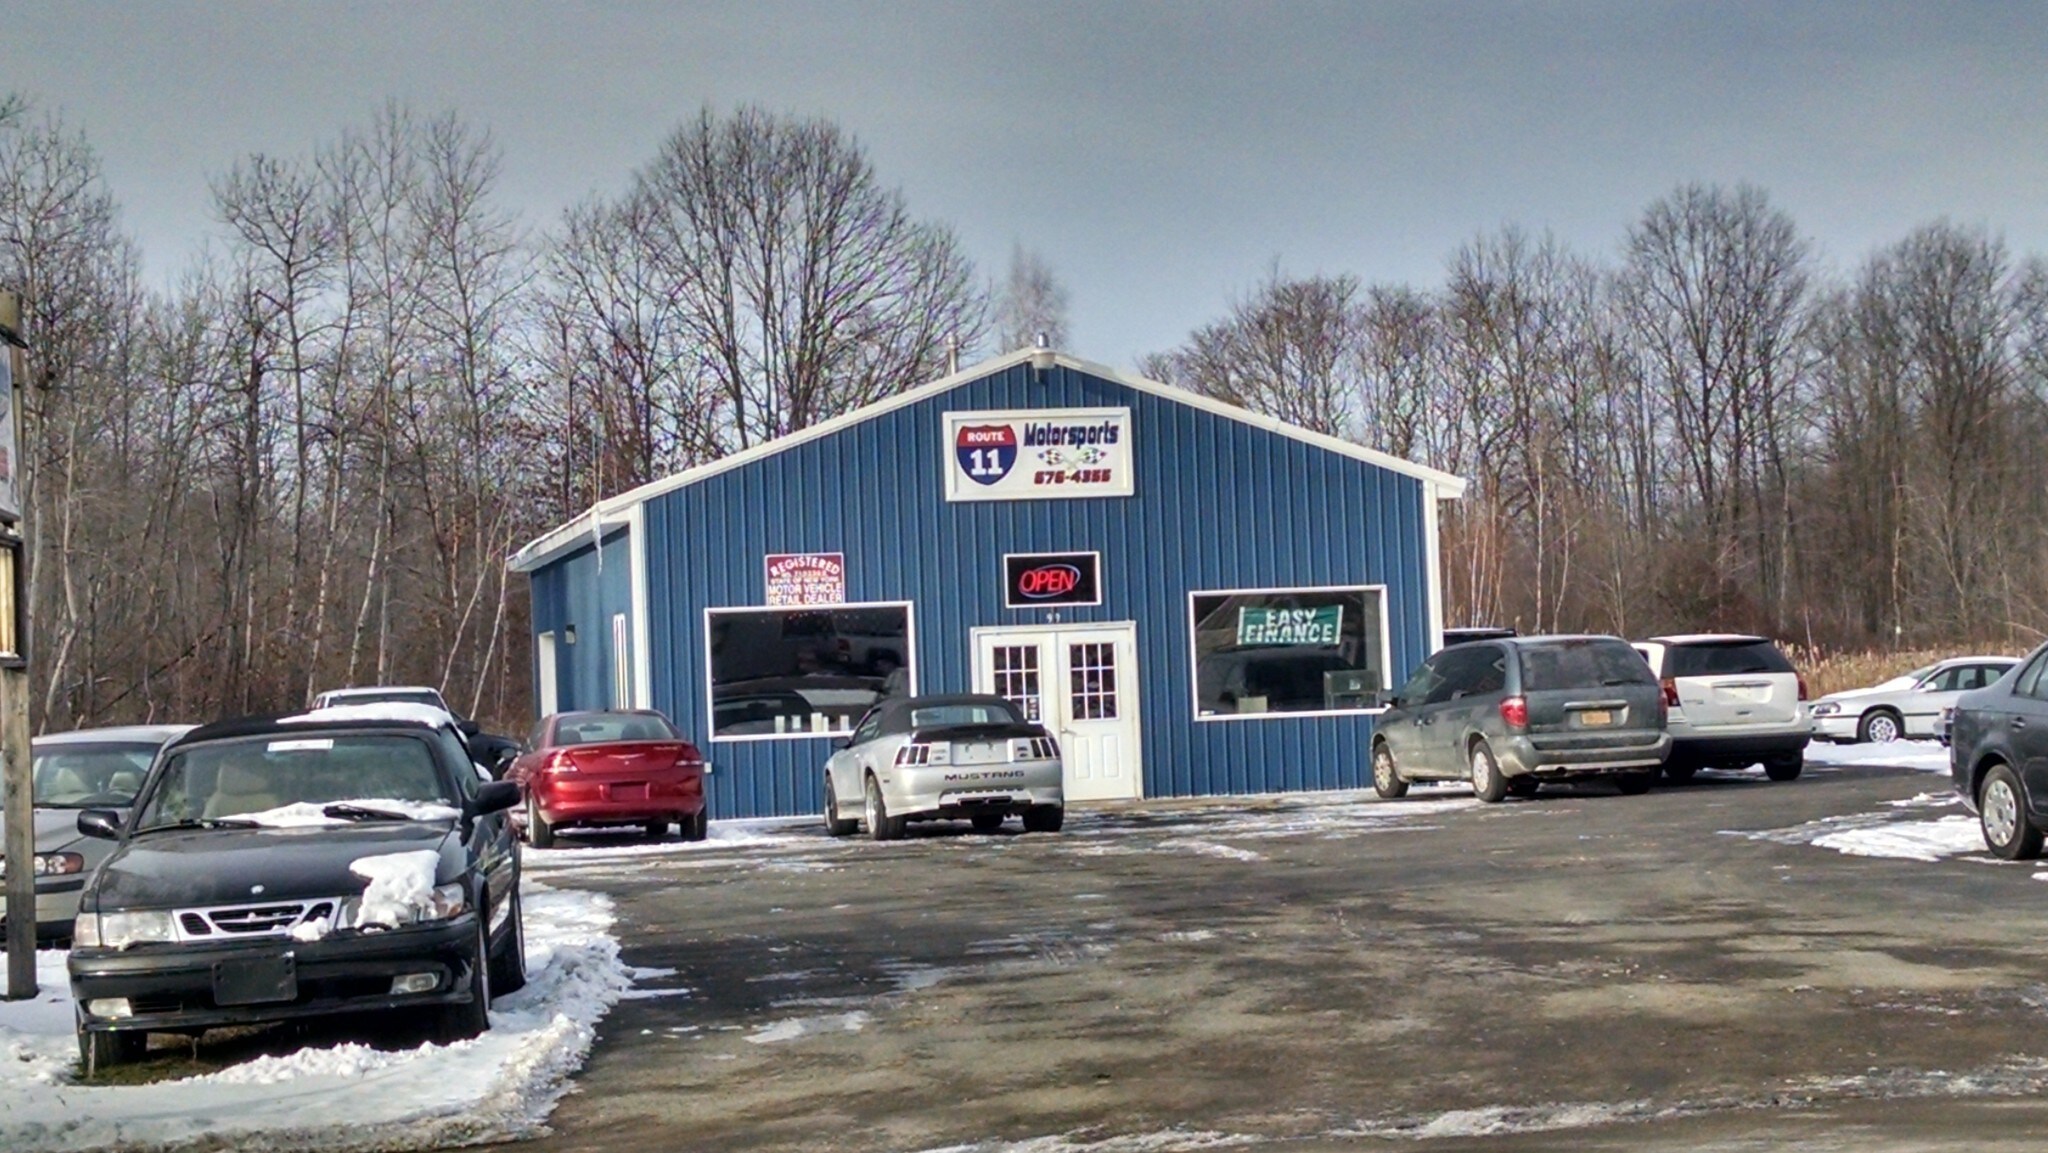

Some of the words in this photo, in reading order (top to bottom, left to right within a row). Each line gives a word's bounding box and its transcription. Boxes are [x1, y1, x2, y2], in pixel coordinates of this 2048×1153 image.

[967, 431, 1005, 442] ROUTE
[1024, 420, 1119, 449] Motorsports
[970, 448, 1004, 475] 11
[770, 556, 840, 576] REGISTERED
[768, 584, 802, 594] MOTOR
[803, 582, 842, 593] VEHICLE
[1020, 570, 1075, 592] OPEN
[769, 594, 802, 605] RETAIL
[804, 593, 842, 604] DEALER
[1266, 609, 1317, 627] EASY
[944, 770, 1025, 781] MUSTANG
